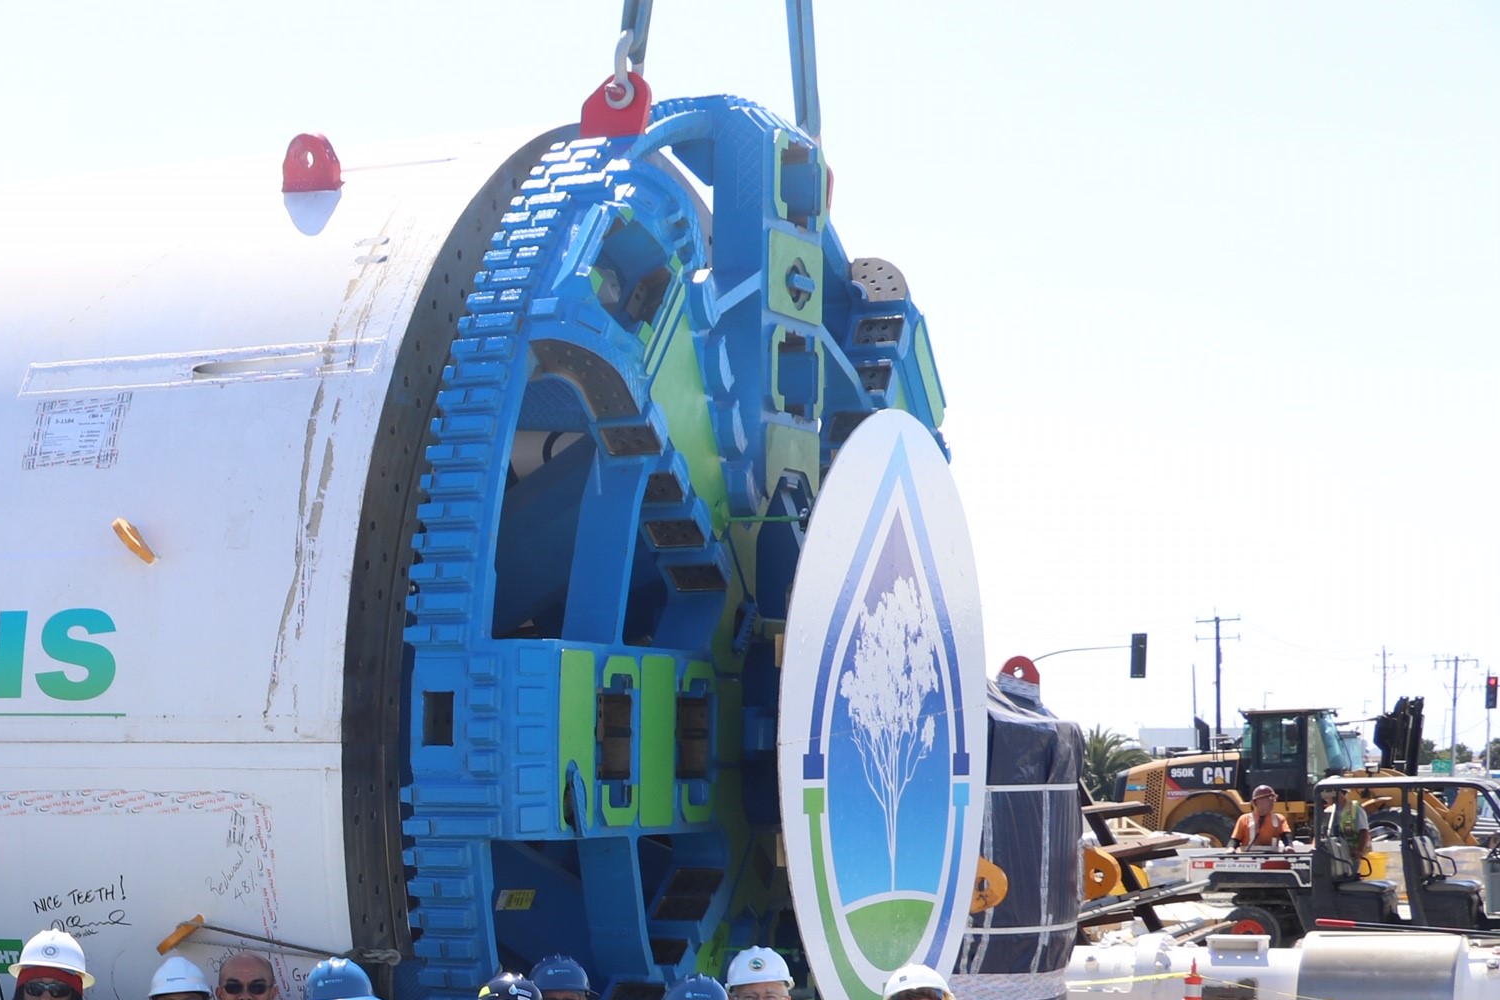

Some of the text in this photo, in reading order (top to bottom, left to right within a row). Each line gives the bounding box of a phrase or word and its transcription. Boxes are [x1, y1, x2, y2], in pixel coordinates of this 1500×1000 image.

[1170, 766, 1233, 785] 950K CAT
[33, 874, 127, 914] NICE TEETH!
